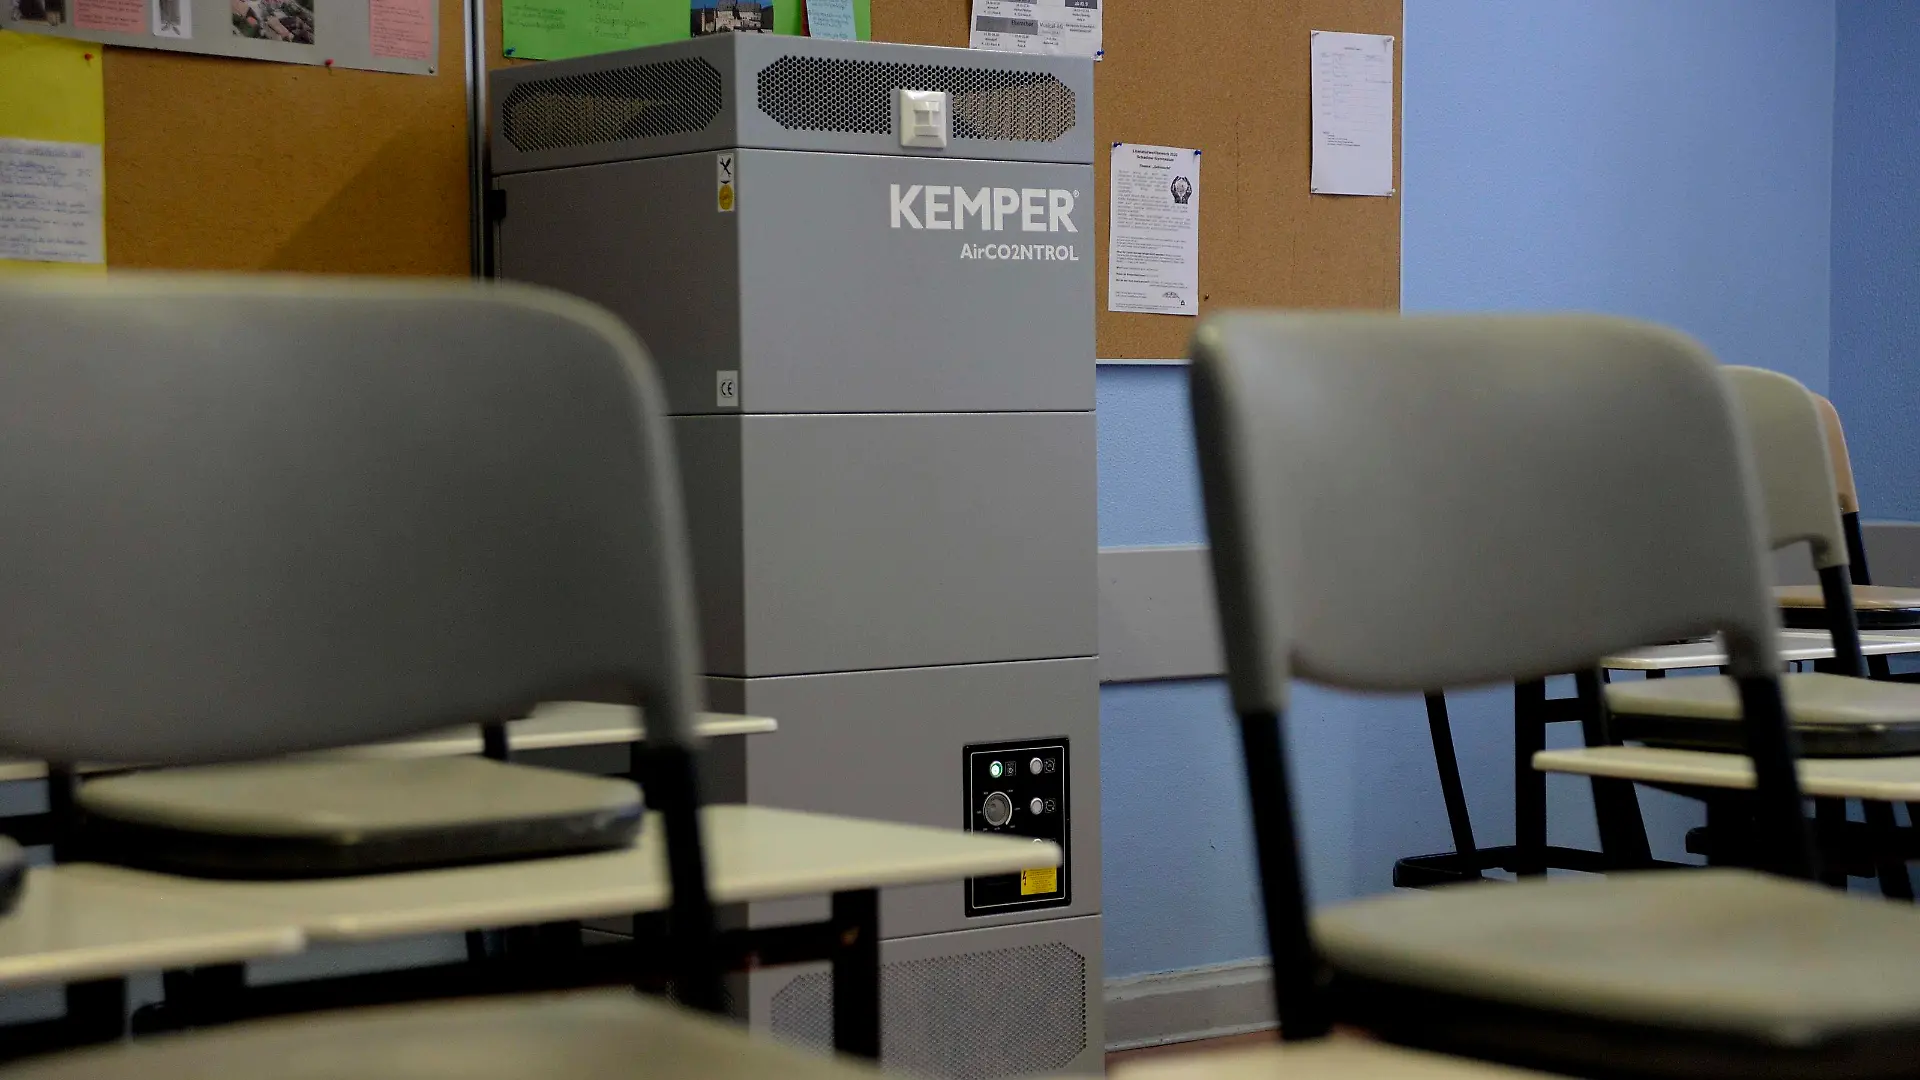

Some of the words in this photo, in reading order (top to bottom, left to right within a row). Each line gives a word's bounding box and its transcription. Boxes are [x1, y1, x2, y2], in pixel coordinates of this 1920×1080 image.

[890, 184, 1079, 233] KEMPER
[960, 243, 1079, 261] AirCO2NTROL
[721, 381, 733, 396] CE
